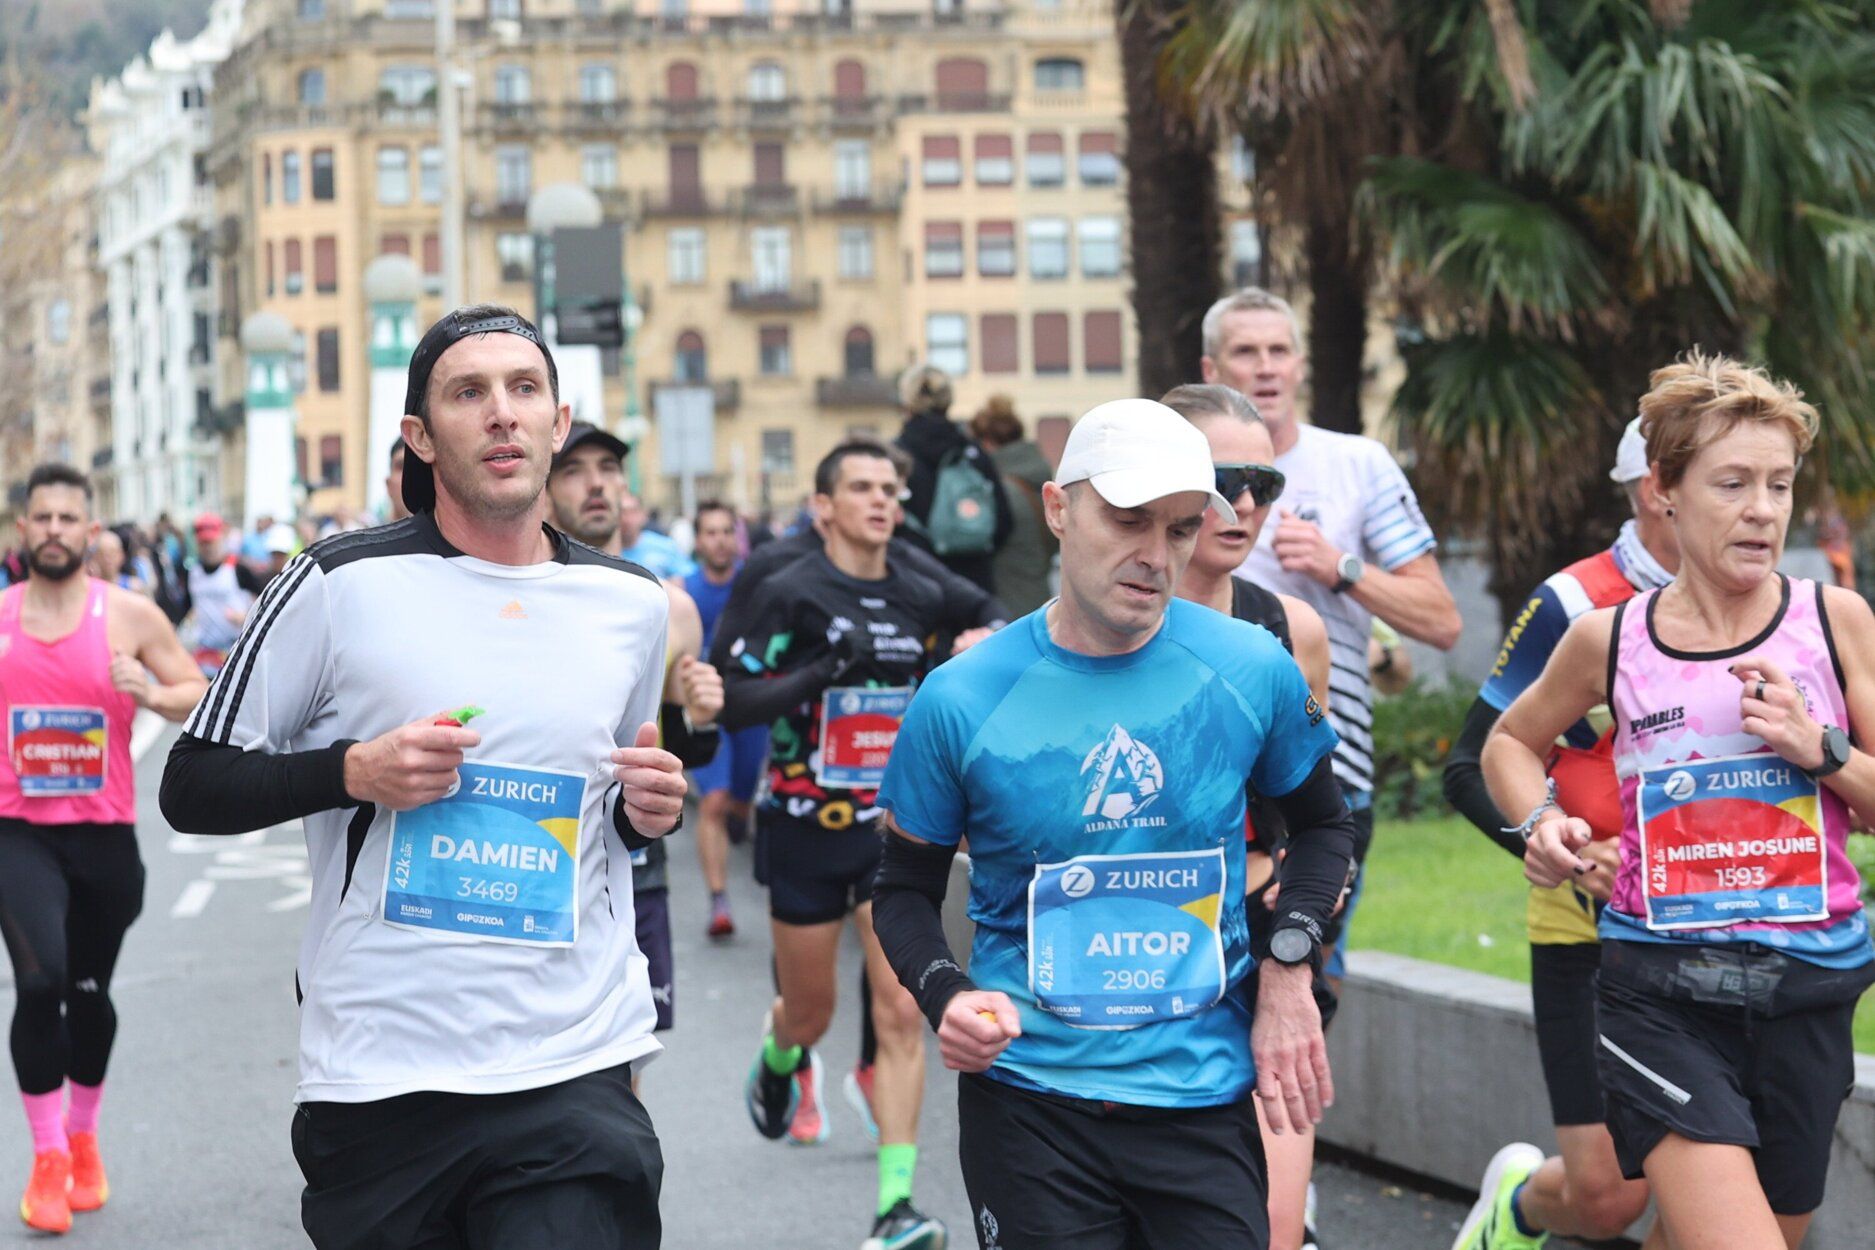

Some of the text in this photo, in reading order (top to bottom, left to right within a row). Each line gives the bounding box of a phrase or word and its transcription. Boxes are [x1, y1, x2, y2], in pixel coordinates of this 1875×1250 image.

[1490, 597, 1543, 677] TOTANA
[471, 776, 557, 805] ZURICH
[1706, 768, 1791, 791] ZURICH
[1084, 816, 1168, 833] ALDANA TRAIL
[430, 834, 558, 874] DAMIEN
[1667, 842, 1735, 863] MIREN
[1737, 836, 1817, 858] JOSUNE
[394, 857, 412, 889] 42k
[1105, 868, 1198, 890] ZURICH
[1714, 865, 1767, 888] 1593
[456, 876, 518, 903] 3469
[400, 904, 433, 916] EUSKADI
[456, 912, 504, 927] GIPUZKOA
[1086, 931, 1192, 957] AITOR
[1102, 969, 1167, 991] 2906
[1106, 1004, 1154, 1015] GIPUZKOA
